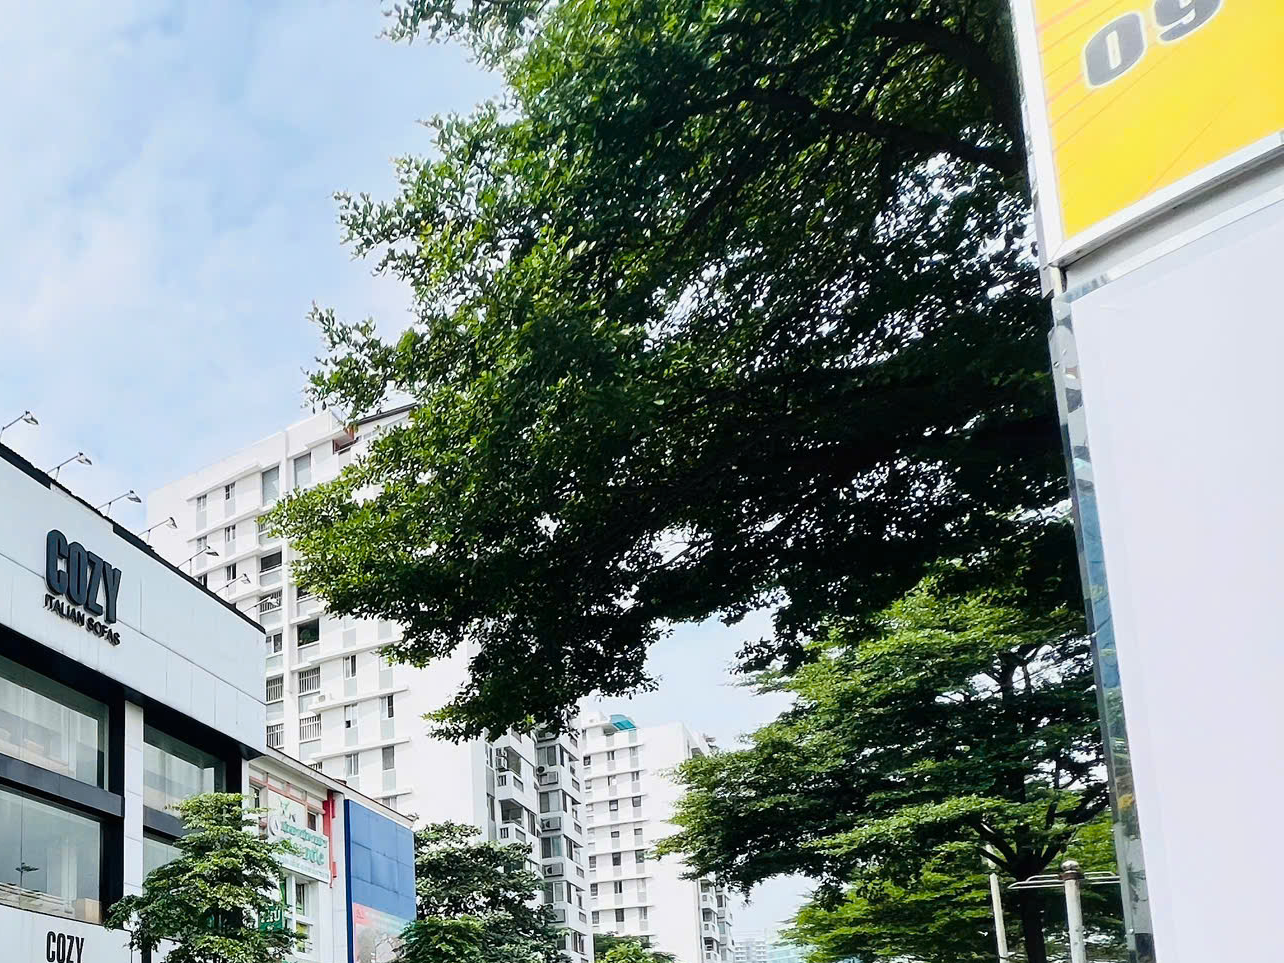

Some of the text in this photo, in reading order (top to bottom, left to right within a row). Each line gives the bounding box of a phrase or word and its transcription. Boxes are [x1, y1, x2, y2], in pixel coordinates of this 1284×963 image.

[45, 529, 122, 625] COZY
[43, 594, 121, 647] ITALIAN SOFAS
